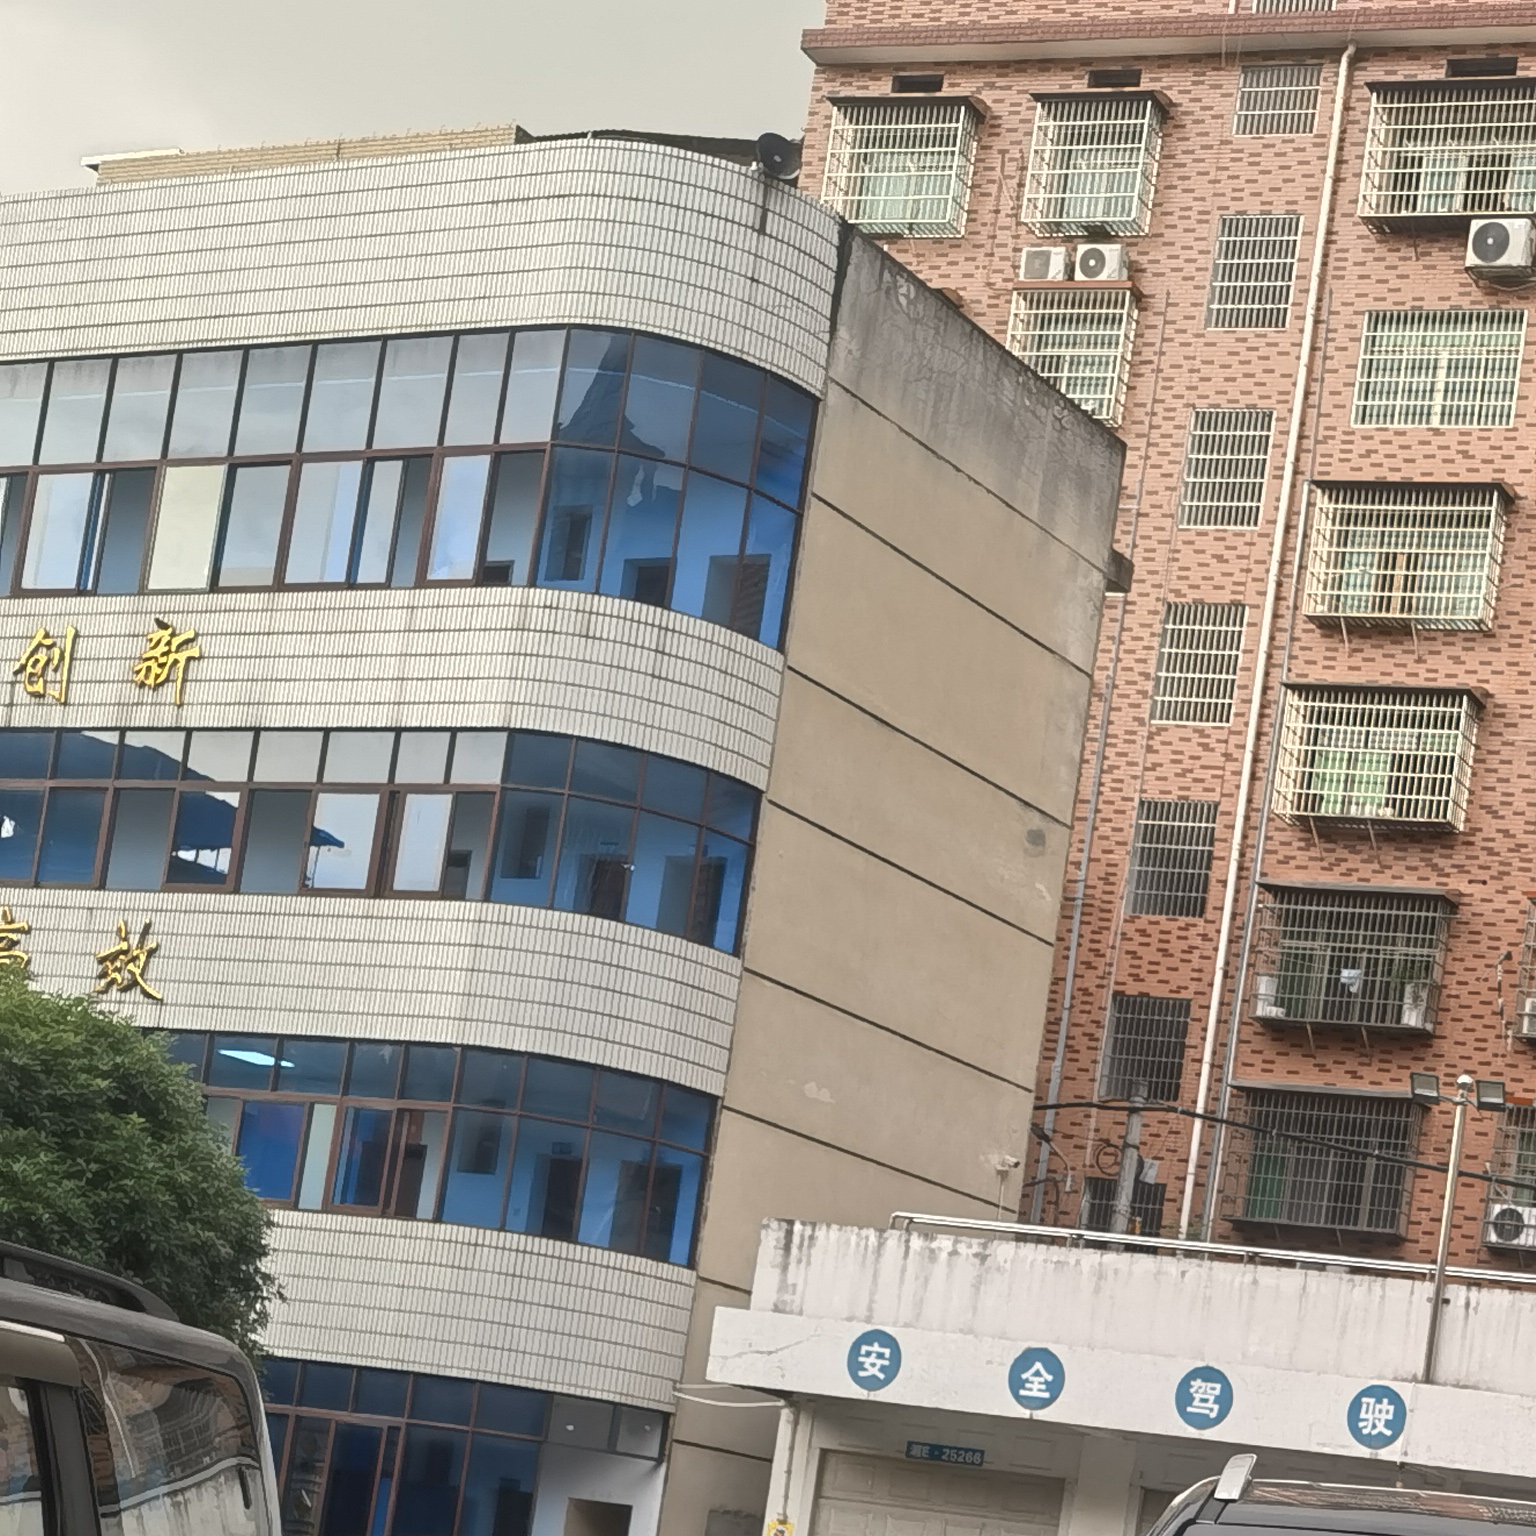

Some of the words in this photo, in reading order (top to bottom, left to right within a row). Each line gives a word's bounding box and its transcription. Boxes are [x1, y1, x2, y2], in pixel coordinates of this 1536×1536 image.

[13, 617, 201, 706] 创新
[857, 1341, 1395, 1437] 安全驾驶
